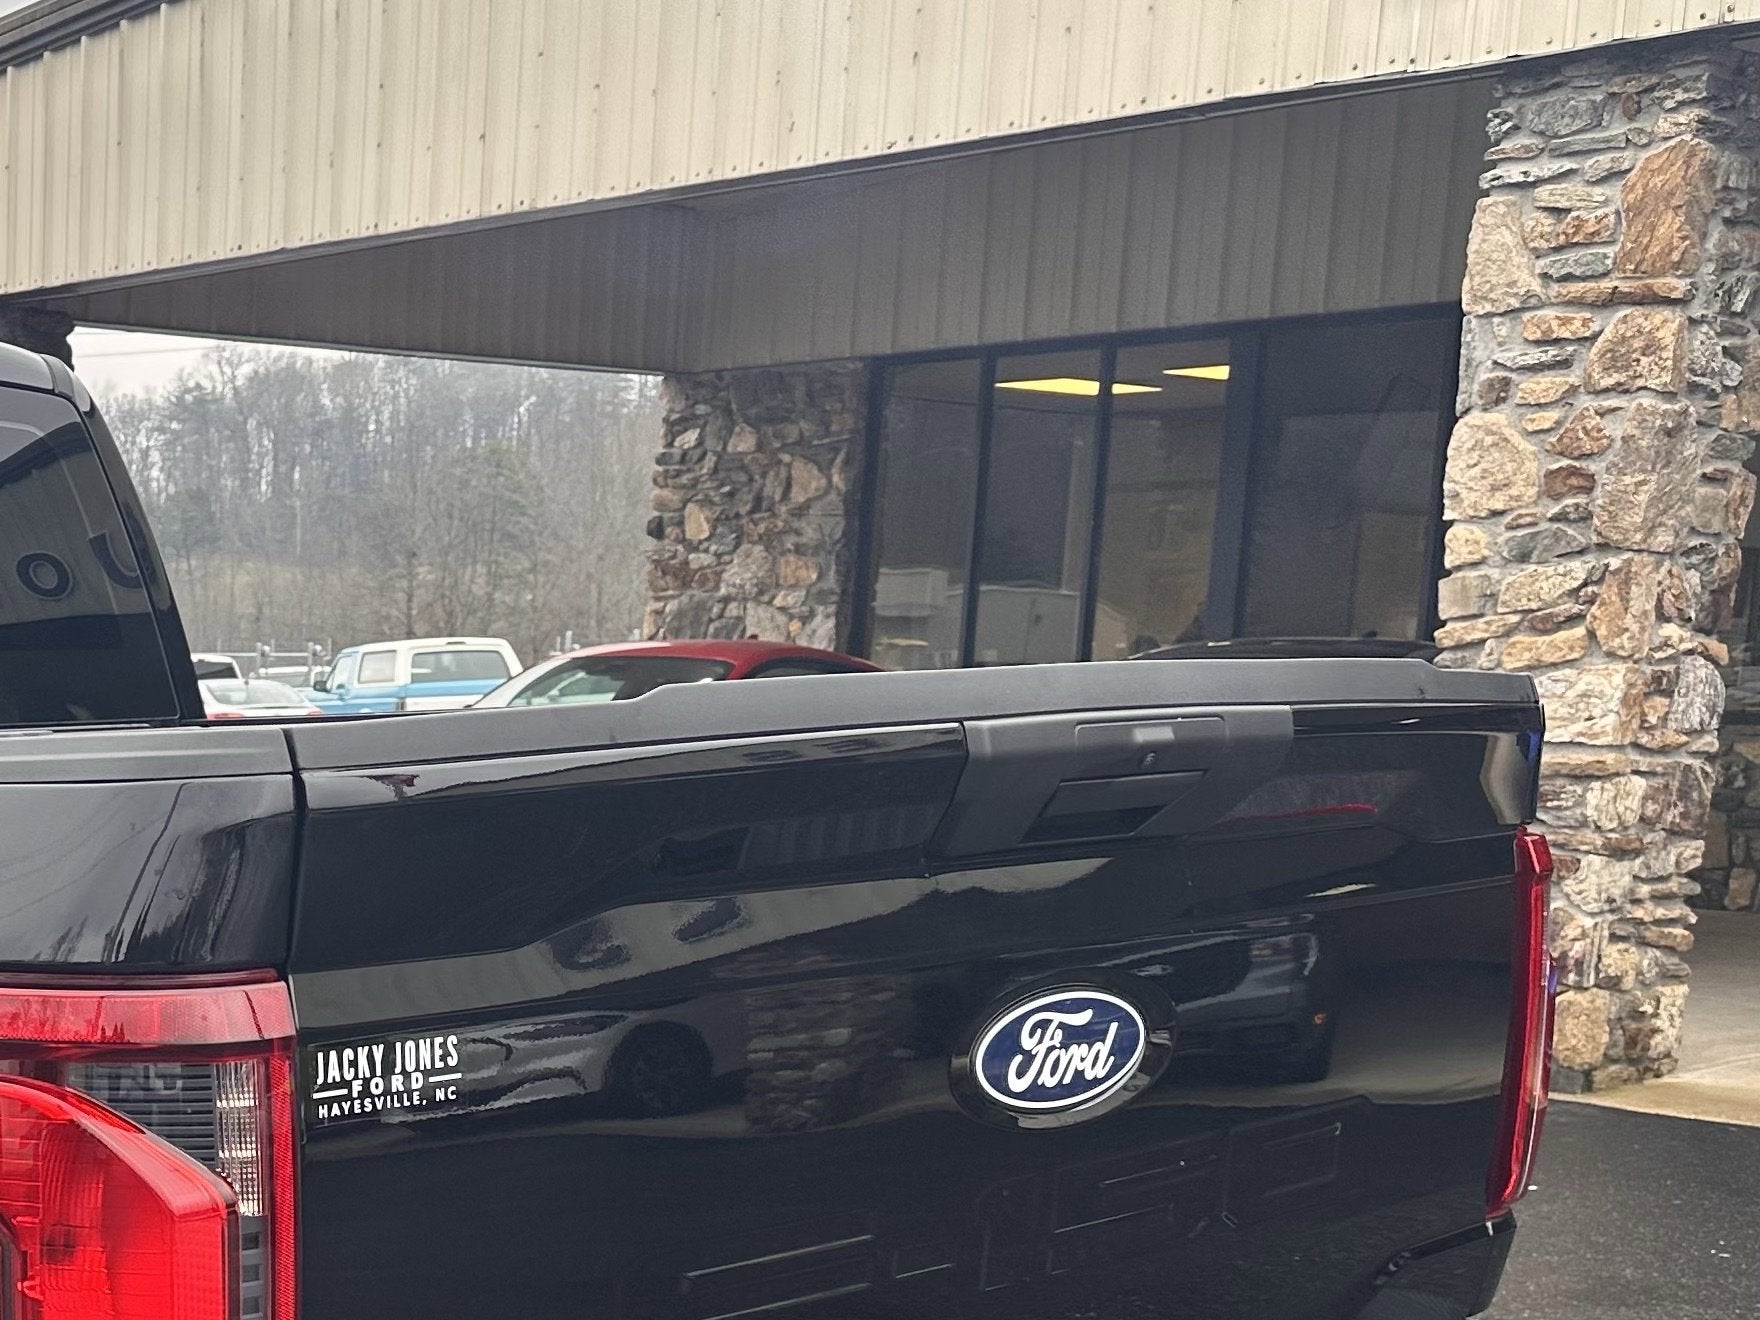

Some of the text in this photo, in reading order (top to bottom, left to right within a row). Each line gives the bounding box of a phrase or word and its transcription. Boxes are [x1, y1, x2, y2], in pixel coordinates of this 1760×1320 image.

[316, 1034, 459, 1085] JACKY JONES
[1007, 1008, 1119, 1093] Ford
[318, 1085, 458, 1119] HAYESVILLE, NC
[351, 1071, 424, 1098] FORD
